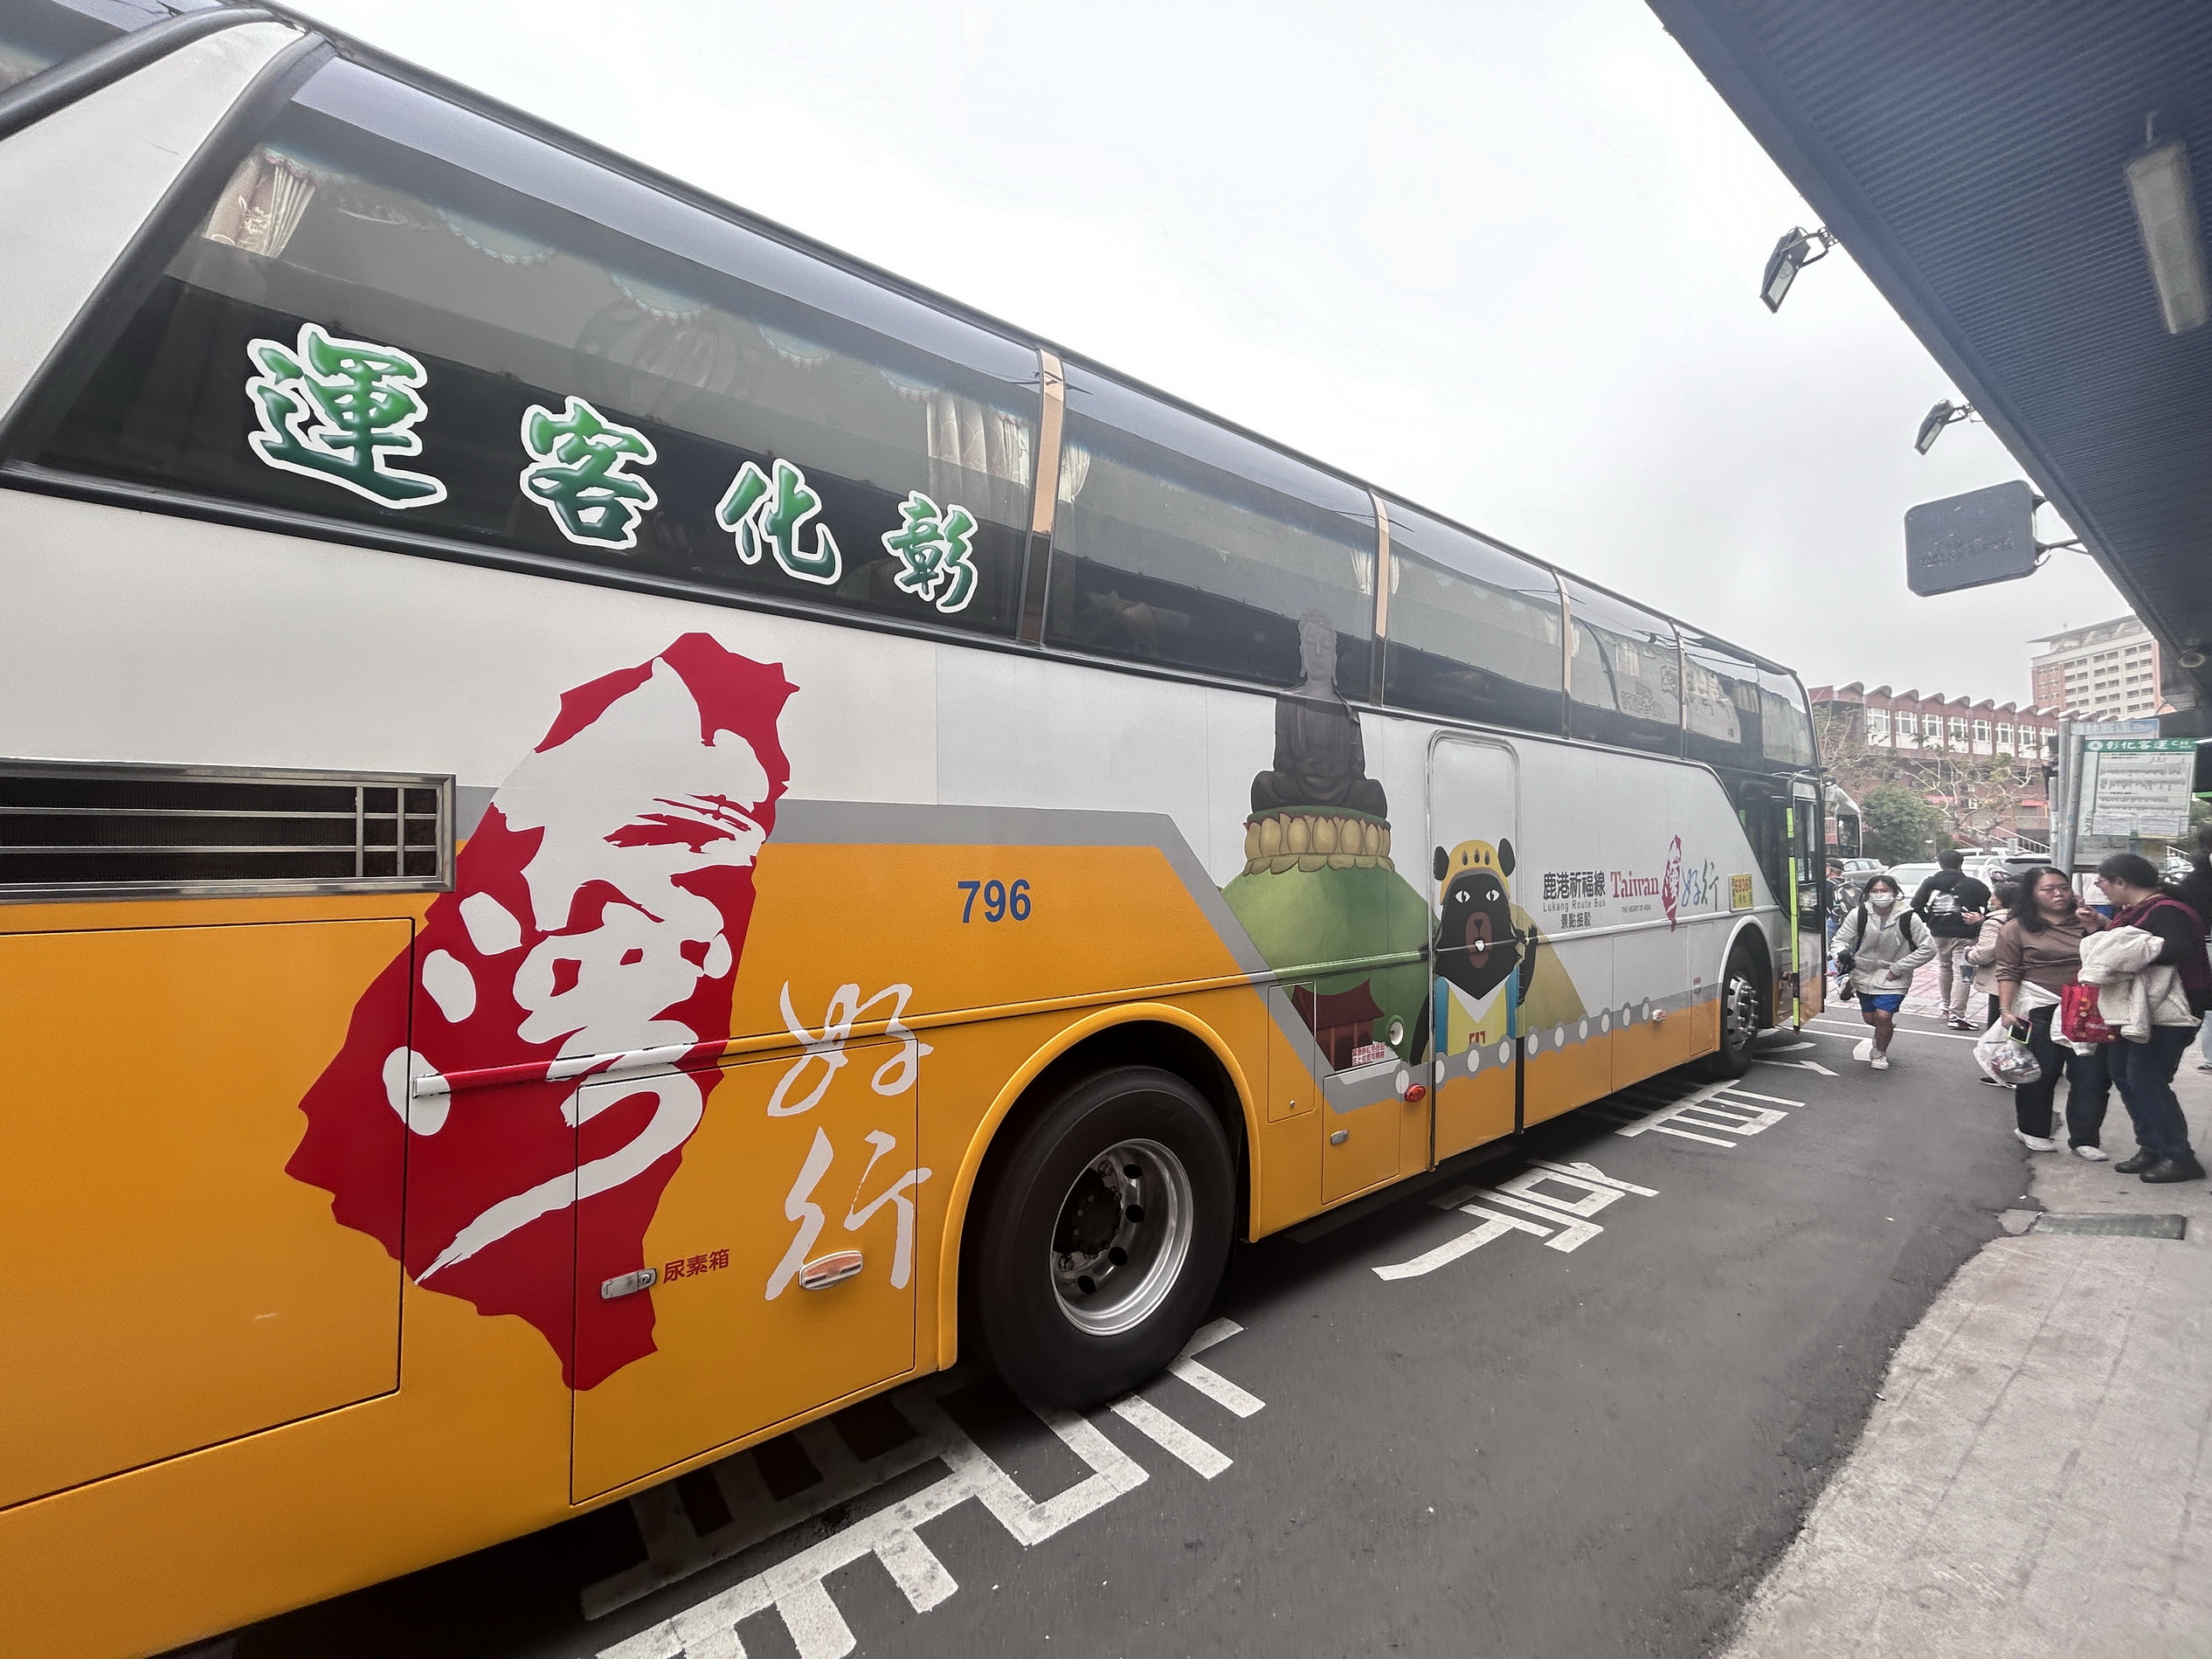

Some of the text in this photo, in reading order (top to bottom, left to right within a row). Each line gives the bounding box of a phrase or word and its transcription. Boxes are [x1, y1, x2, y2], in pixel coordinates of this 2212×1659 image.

[1543, 870, 1606, 901] 鹿港祈福線
[1610, 870, 1660, 899] Taiwan
[957, 878, 1032, 923] 796
[1543, 898, 1606, 912] Lukang Route Bus
[1560, 911, 1591, 930] 景點接駁
[662, 1248, 730, 1284] 尿素箱
